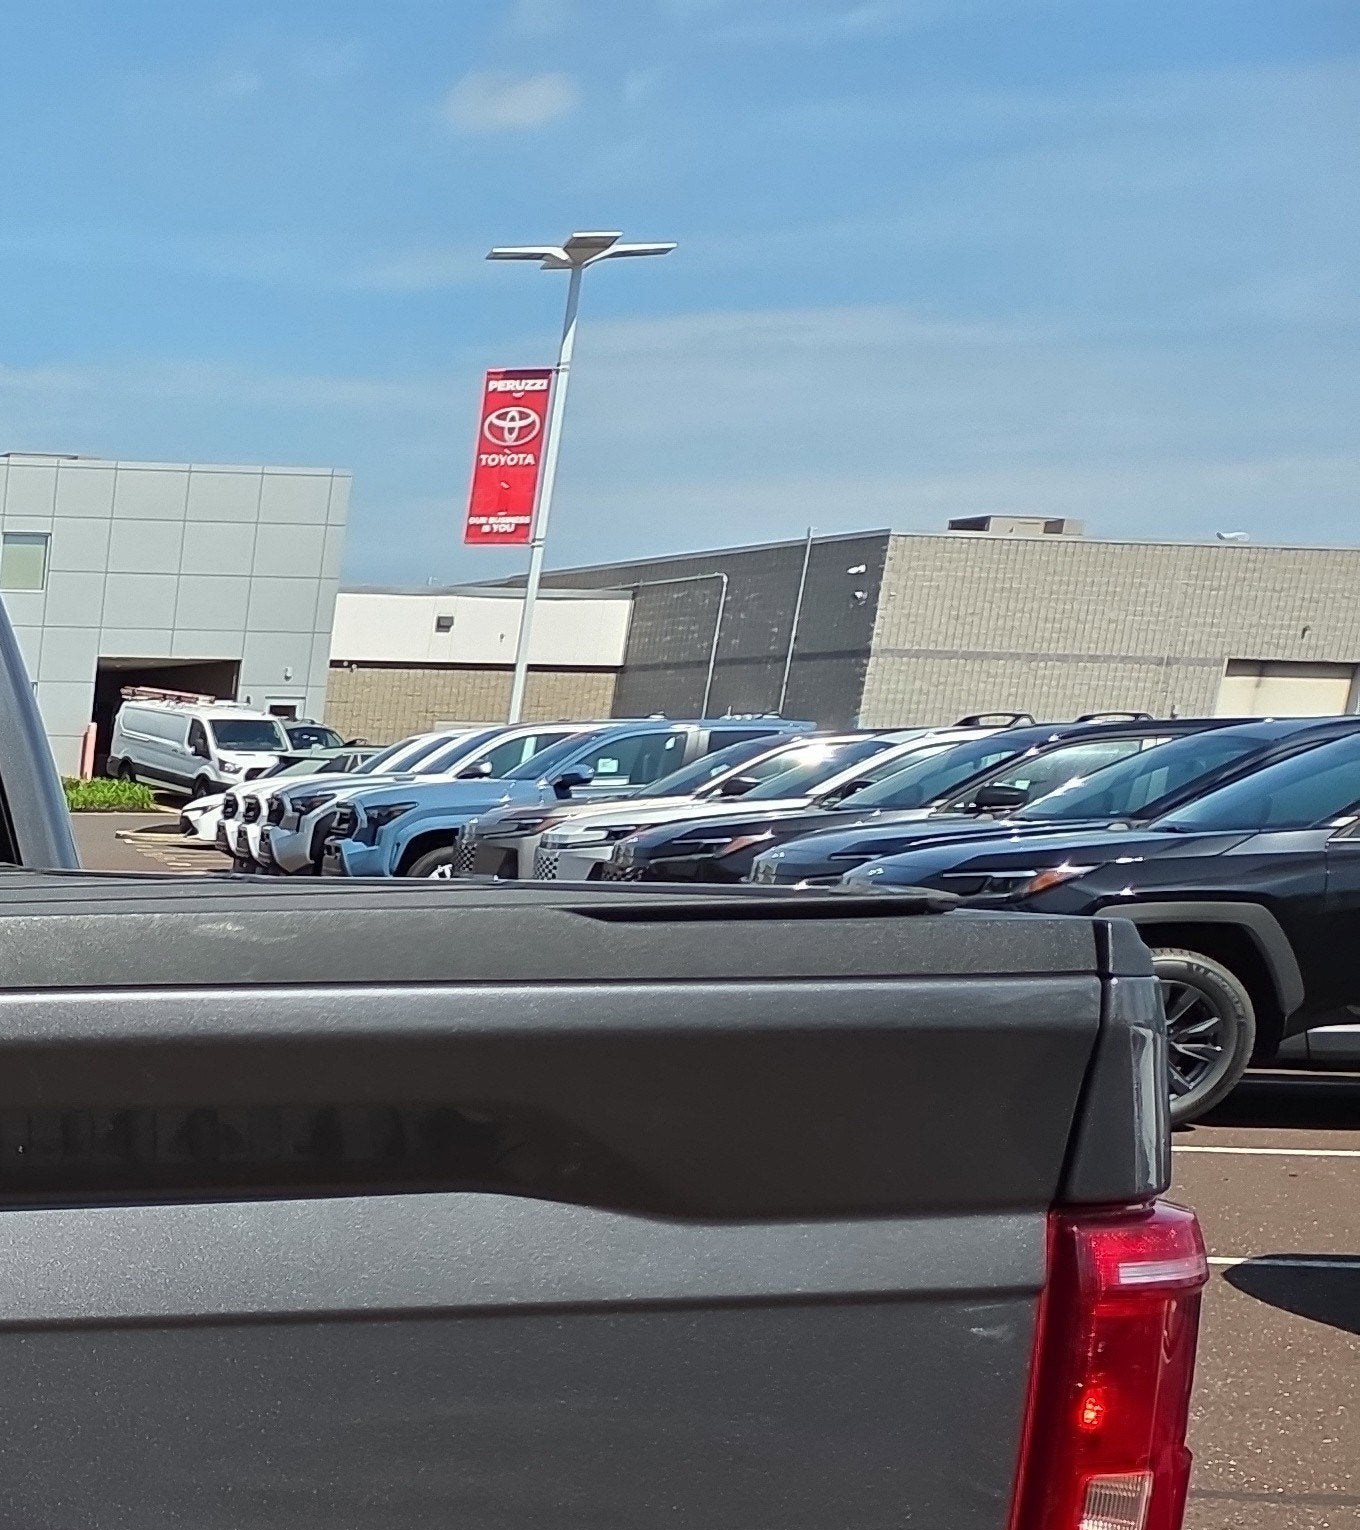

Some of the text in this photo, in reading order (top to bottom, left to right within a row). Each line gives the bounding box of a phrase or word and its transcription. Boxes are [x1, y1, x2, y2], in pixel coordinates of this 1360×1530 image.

[488, 379, 548, 392] PERUZZI
[480, 453, 535, 467] TOYOTA
[492, 523, 515, 533] YOU
